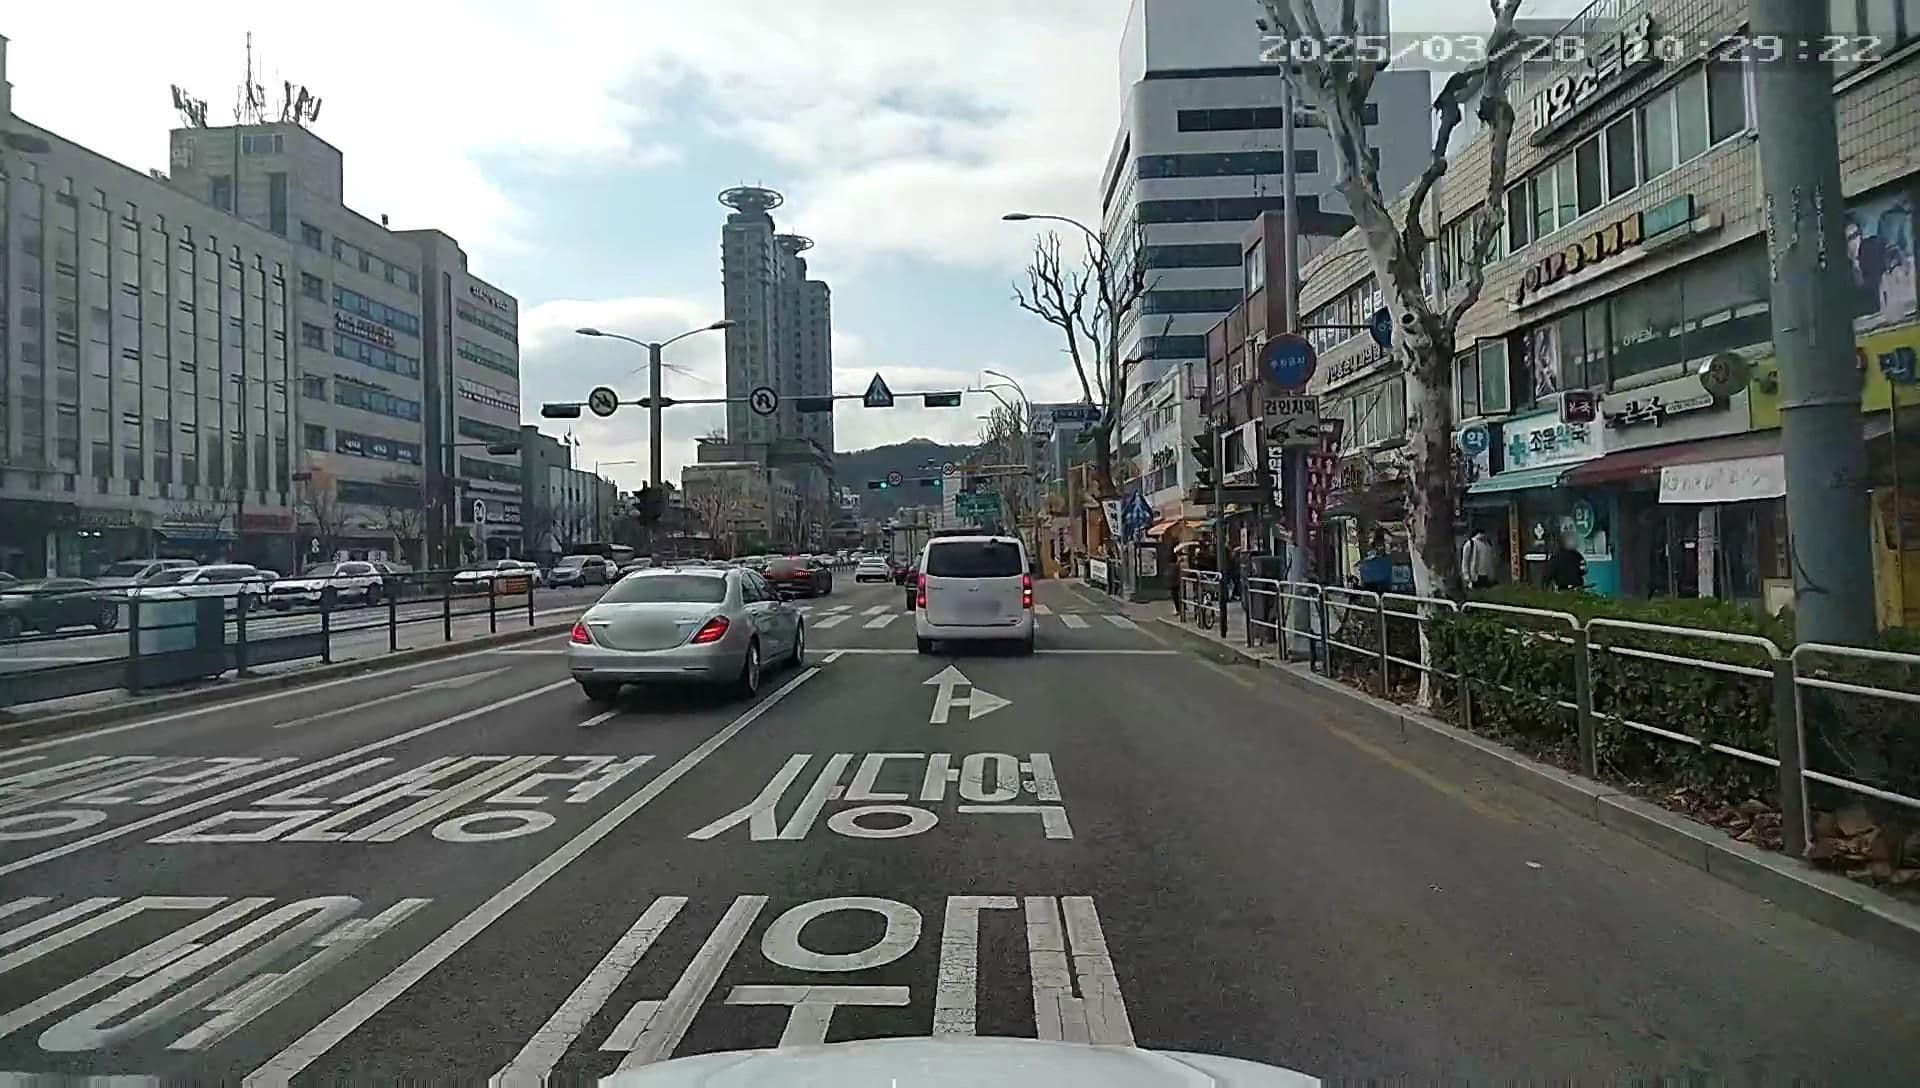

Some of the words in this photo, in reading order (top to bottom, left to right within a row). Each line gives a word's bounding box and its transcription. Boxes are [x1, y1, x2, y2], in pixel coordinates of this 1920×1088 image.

[1265, 399, 1316, 416] 견인지역
[1466, 431, 1485, 448] 약
[145, 755, 656, 843] 남태령
[684, 752, 1074, 841] 사당역
